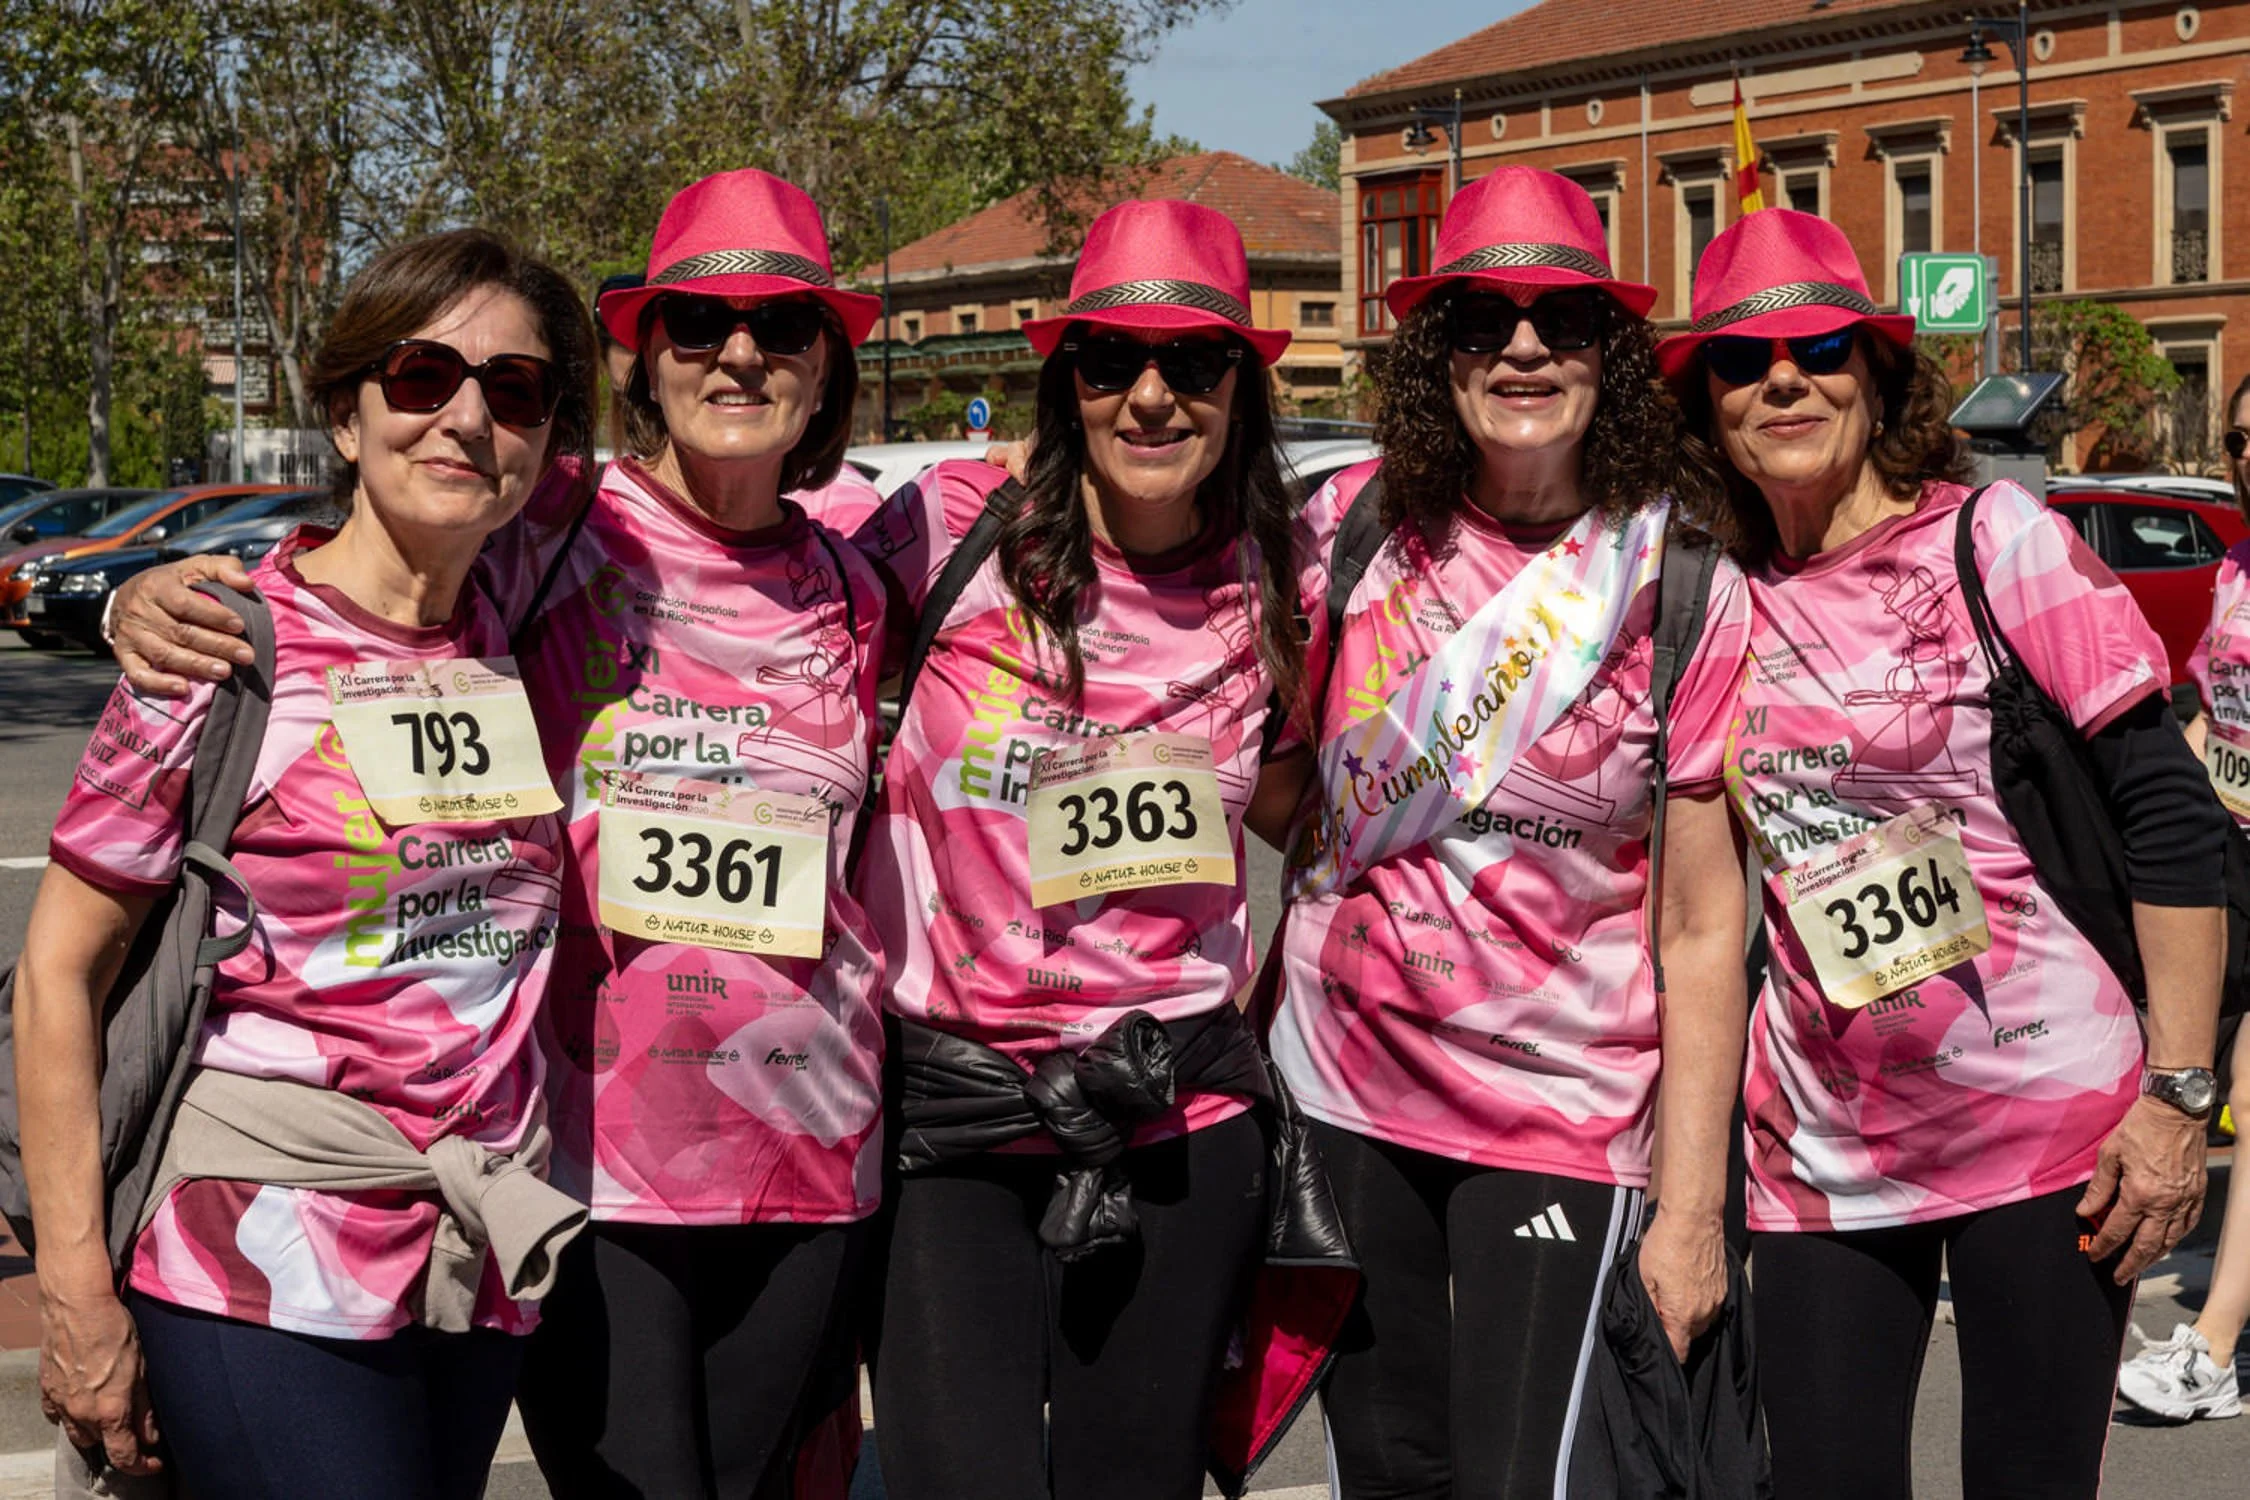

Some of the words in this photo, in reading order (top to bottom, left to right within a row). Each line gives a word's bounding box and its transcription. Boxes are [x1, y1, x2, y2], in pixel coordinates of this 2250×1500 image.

[626, 642, 660, 675] XI
[338, 674, 352, 687] XI
[354, 675, 390, 686] Carrera
[626, 683, 767, 728] Carrera
[959, 645, 1022, 799] mujer
[1741, 705, 1769, 738] XI
[391, 711, 490, 777] 793
[624, 731, 688, 766] por
[696, 732, 730, 764] la
[1052, 757, 1084, 770] Carrera
[1085, 753, 1099, 765] por
[1099, 751, 1108, 760] la
[1739, 742, 1851, 778] Carrera
[635, 786, 676, 799] Carrera
[678, 793, 697, 803] por
[698, 793, 708, 802] la
[1752, 788, 1798, 826] por
[1799, 782, 1838, 808] la
[1058, 780, 1197, 856] 3363
[398, 834, 513, 870] Carrera
[632, 827, 783, 908] 3361
[334, 789, 400, 968] mujer
[1094, 866, 1136, 884] NATUR
[1140, 862, 1182, 876] HOUSE
[1807, 860, 1842, 879] Carrera
[397, 886, 453, 928] por
[458, 879, 483, 913] la
[1404, 908, 1420, 923] La
[1422, 911, 1453, 931] Rioja
[1825, 858, 1961, 959] 3364
[663, 918, 710, 935] NATUR
[713, 925, 756, 941] HOUSE
[1025, 925, 1041, 940] La
[1044, 928, 1076, 947] Rioja
[1890, 953, 1933, 979] NATUR
[1994, 1019, 2046, 1048] Ferrer
[764, 1047, 810, 1066] Ferrer
